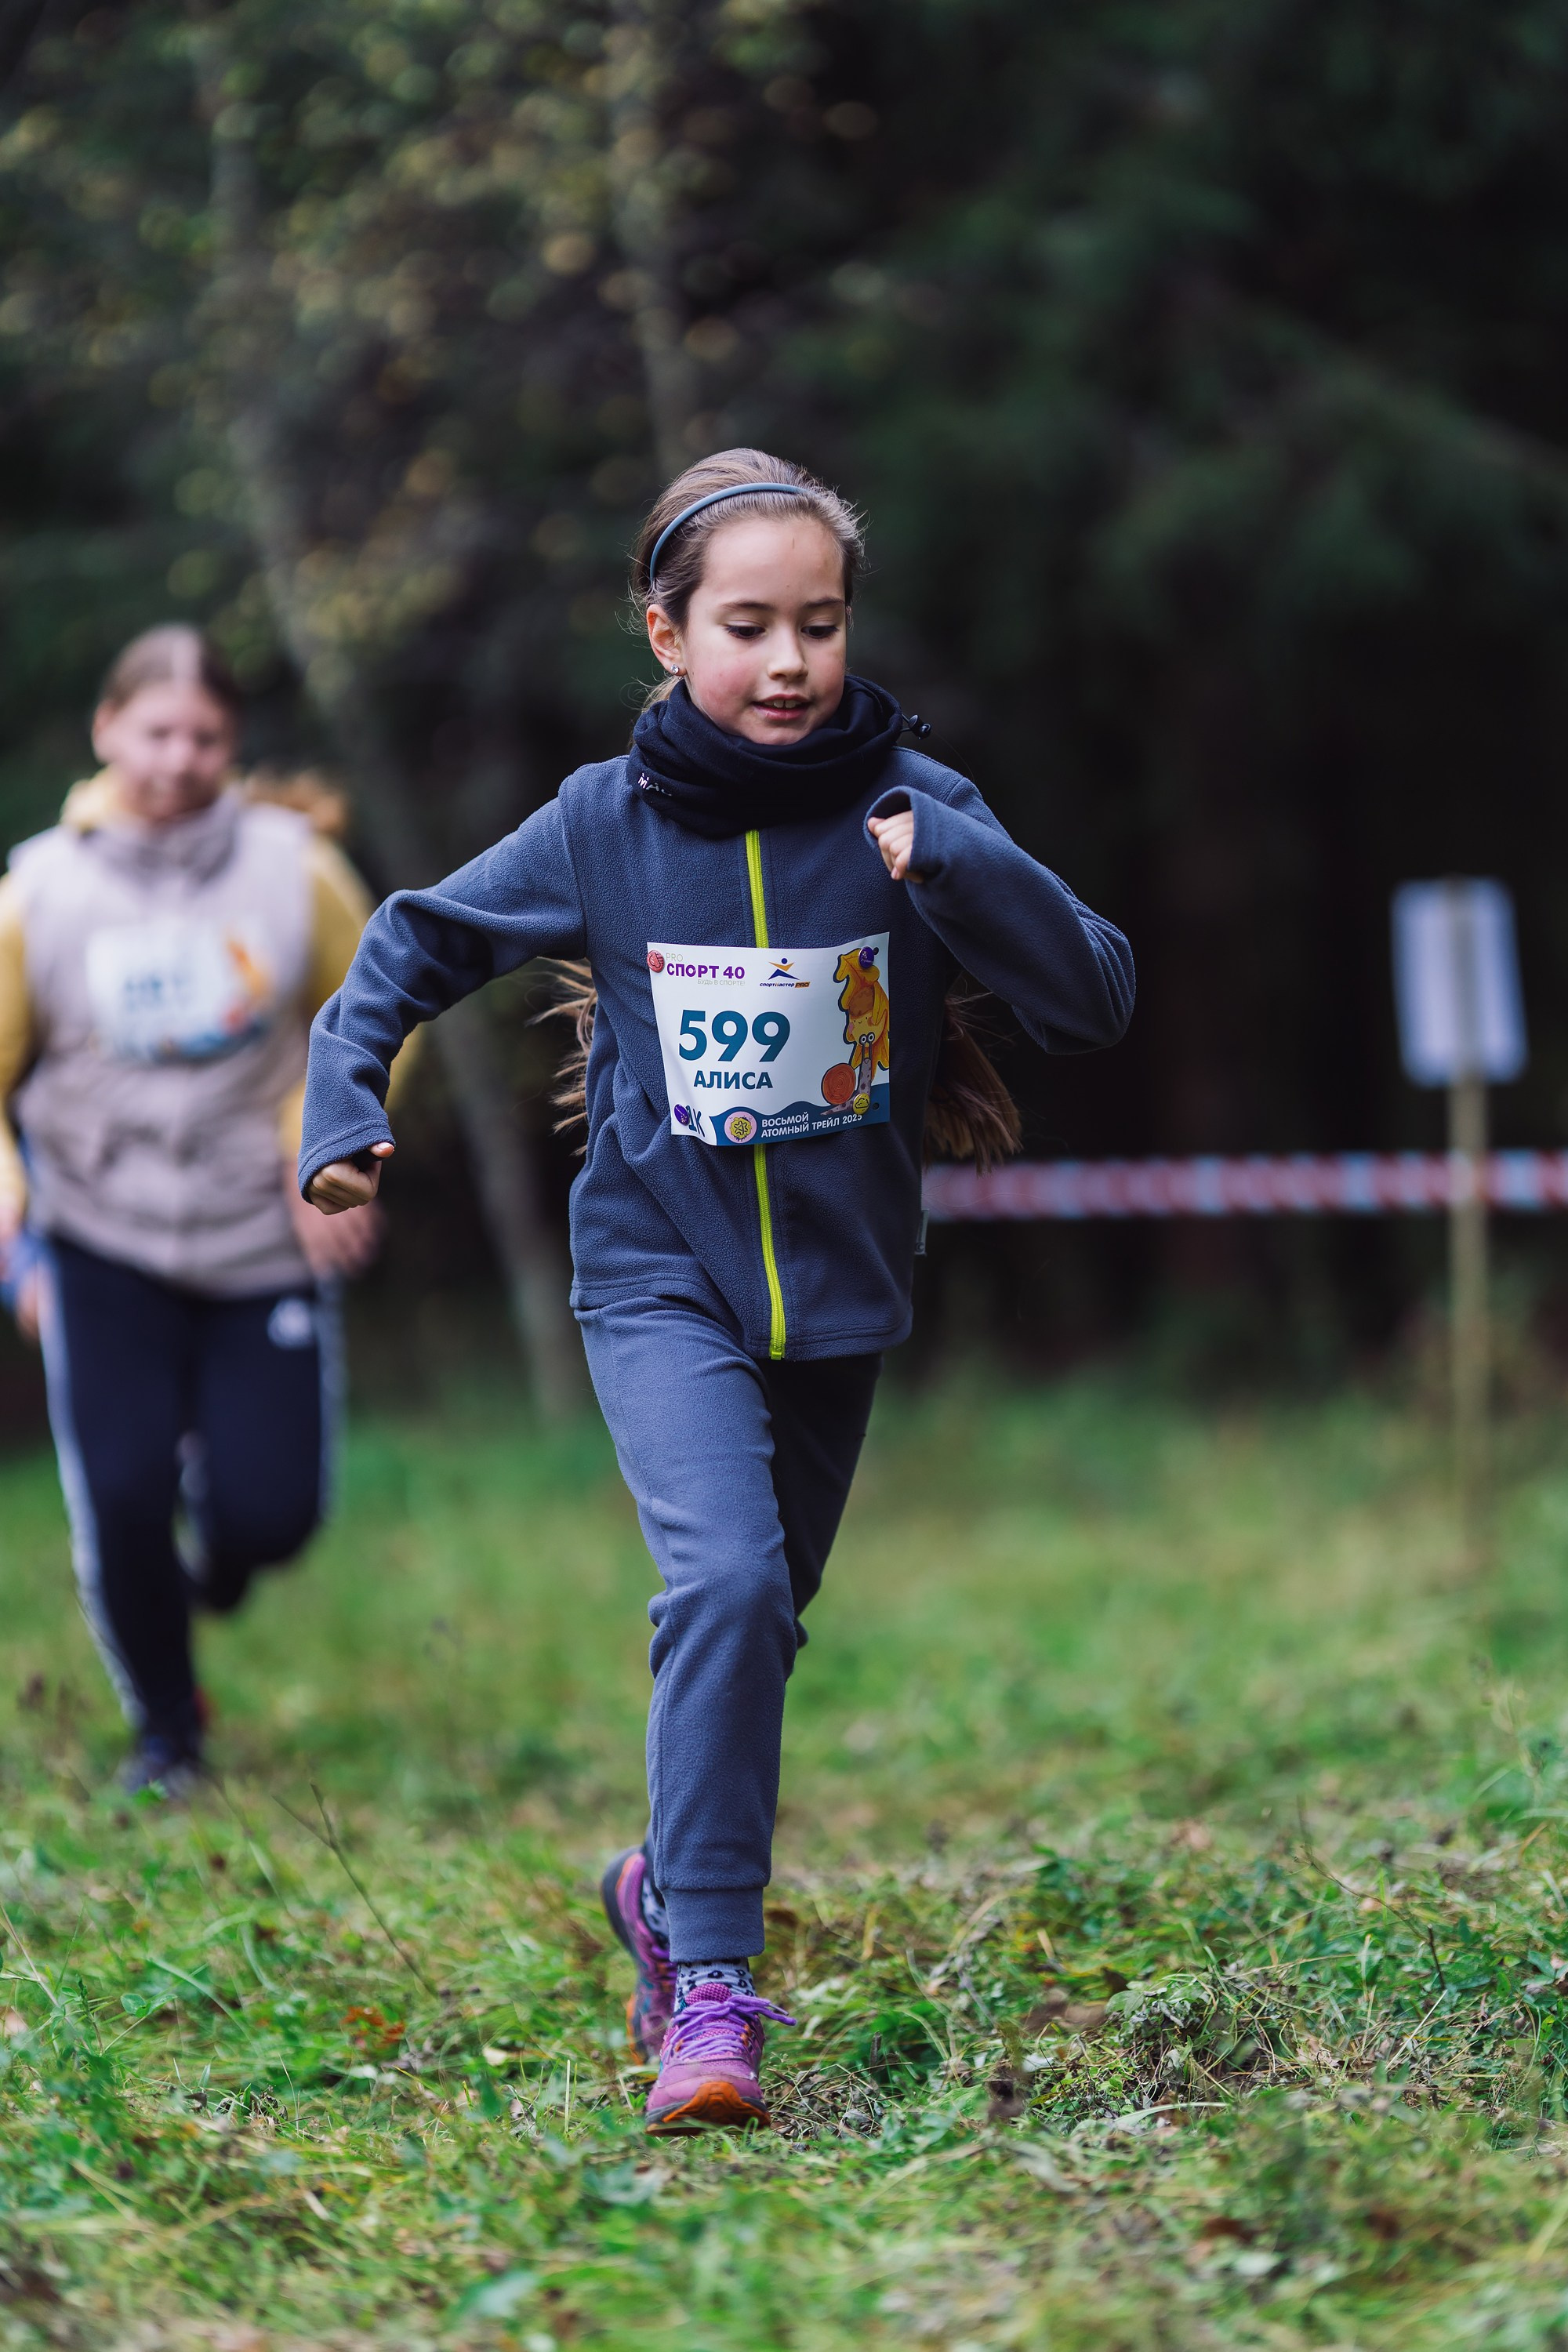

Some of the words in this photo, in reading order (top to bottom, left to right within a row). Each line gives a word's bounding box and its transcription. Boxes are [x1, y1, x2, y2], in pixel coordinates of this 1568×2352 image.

[666, 953, 684, 962] PRO
[666, 963, 719, 978] СПОРТ
[723, 966, 746, 979] 40
[679, 1009, 790, 1062] 599
[693, 1070, 774, 1090] АЛИСА
[761, 1112, 809, 1127] ВОСЬМОЙ
[761, 1122, 809, 1138] АТОМНЫЙ
[812, 1116, 840, 1130] ТРЕЙЛ
[842, 1113, 862, 1124] 2025
